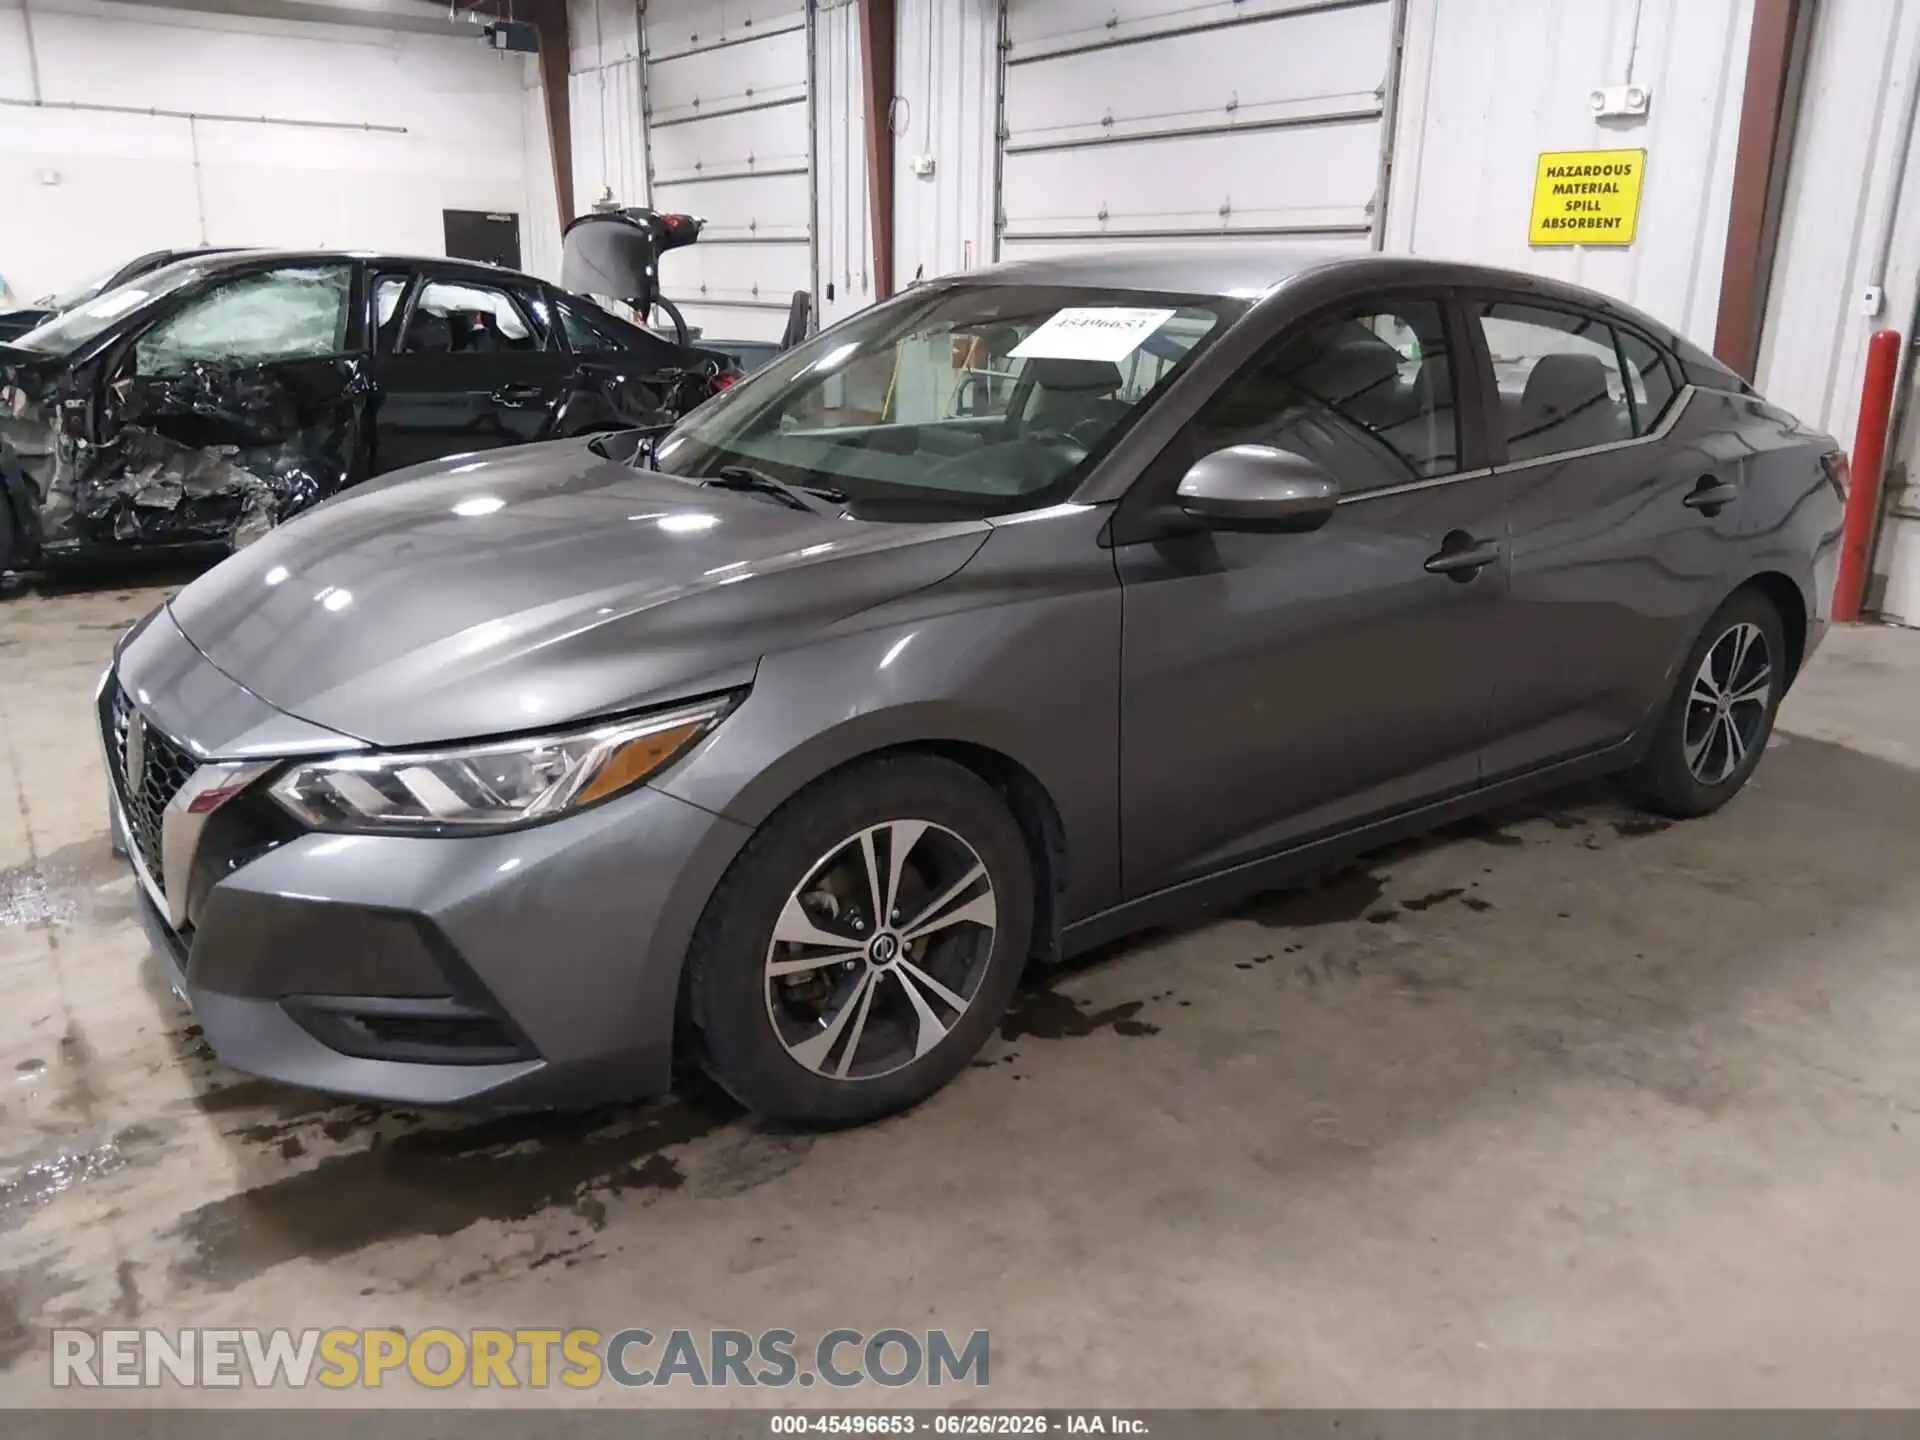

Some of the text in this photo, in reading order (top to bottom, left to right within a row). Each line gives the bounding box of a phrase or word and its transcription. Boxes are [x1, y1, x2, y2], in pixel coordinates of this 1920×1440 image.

[1546, 163, 1632, 178] HAZARDOUS
[1552, 182, 1620, 195] MATERIAL
[1565, 200, 1601, 212] SPILL
[1541, 217, 1622, 229] ABSORBENT
